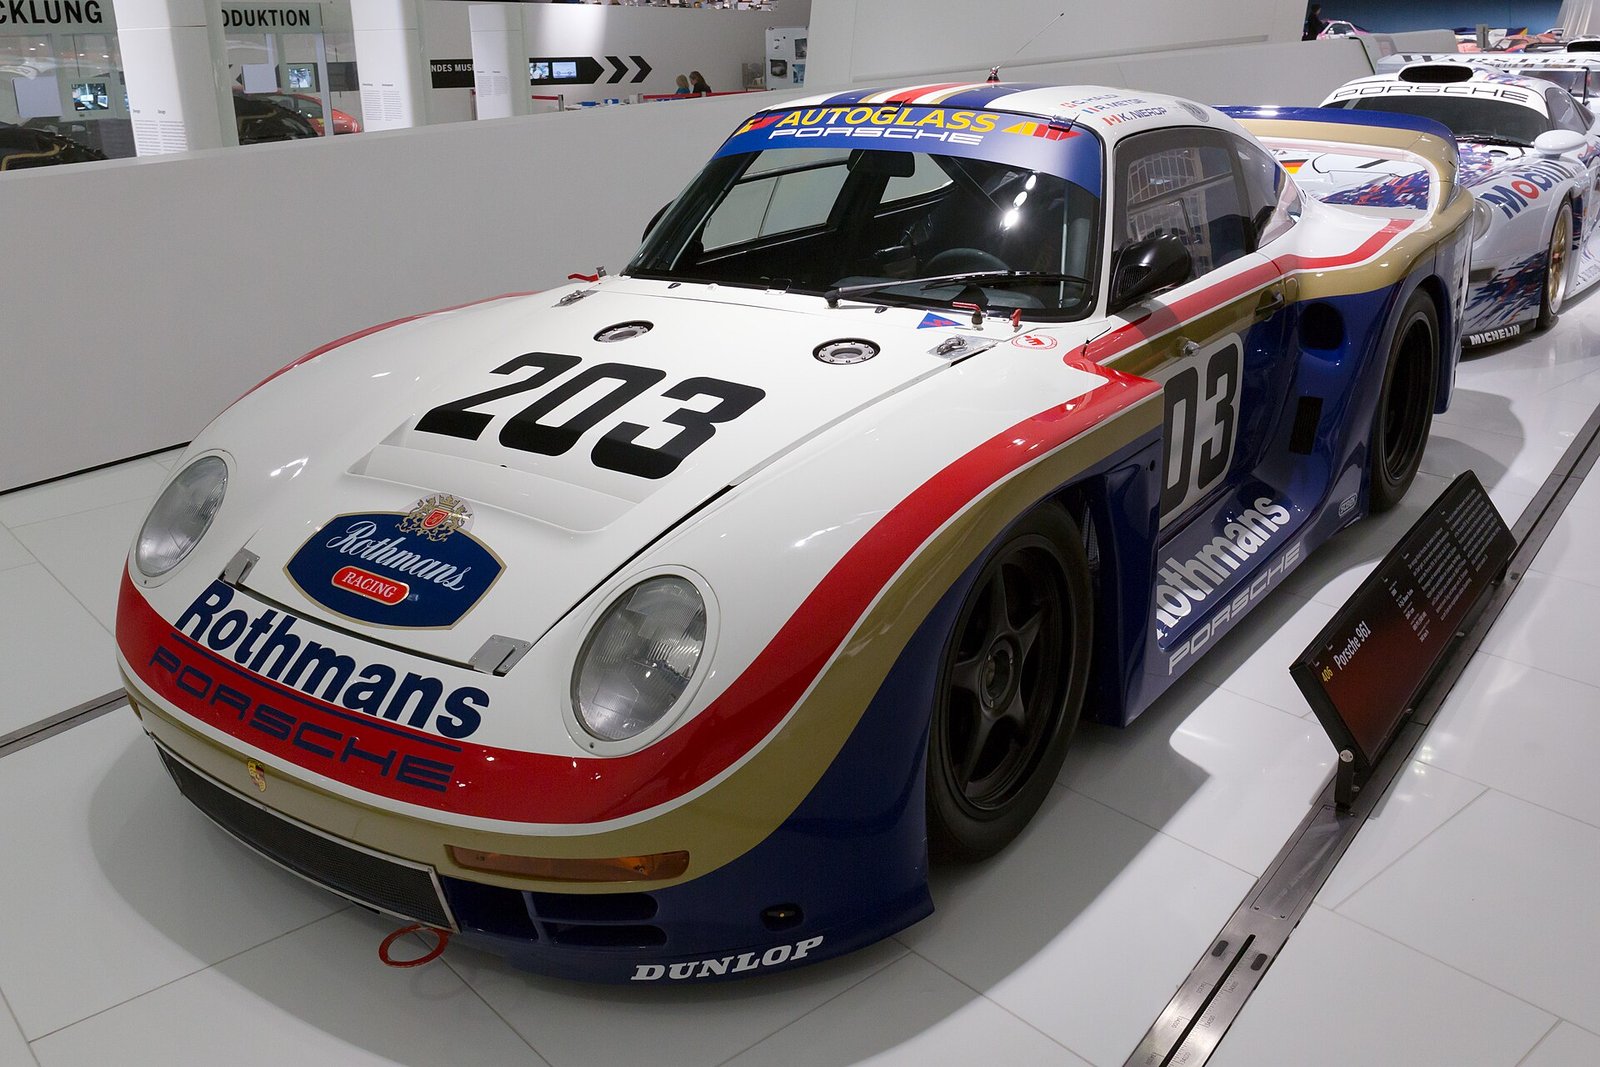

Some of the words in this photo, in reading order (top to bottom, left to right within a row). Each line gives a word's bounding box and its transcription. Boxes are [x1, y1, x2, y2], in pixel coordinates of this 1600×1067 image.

[454, 63, 474, 72] MUS
[775, 106, 1000, 132] AUTOGLASS
[1334, 85, 1529, 103] PORSCHE
[768, 127, 984, 146] PORSCHE
[1480, 165, 1563, 220] Mobil
[1469, 324, 1521, 346] MICHELIN
[413, 351, 766, 480] 203
[325, 520, 472, 591] Rothmans
[342, 571, 398, 598] RACING
[1168, 541, 1301, 676] PORSCHE
[174, 578, 490, 739] Rothmans
[1321, 665, 1334, 682] 406
[1333, 637, 1361, 671] Porsche
[1355, 620, 1371, 642] 961
[149, 645, 455, 793] PORSCHE
[630, 935, 824, 981] DUNLOP
